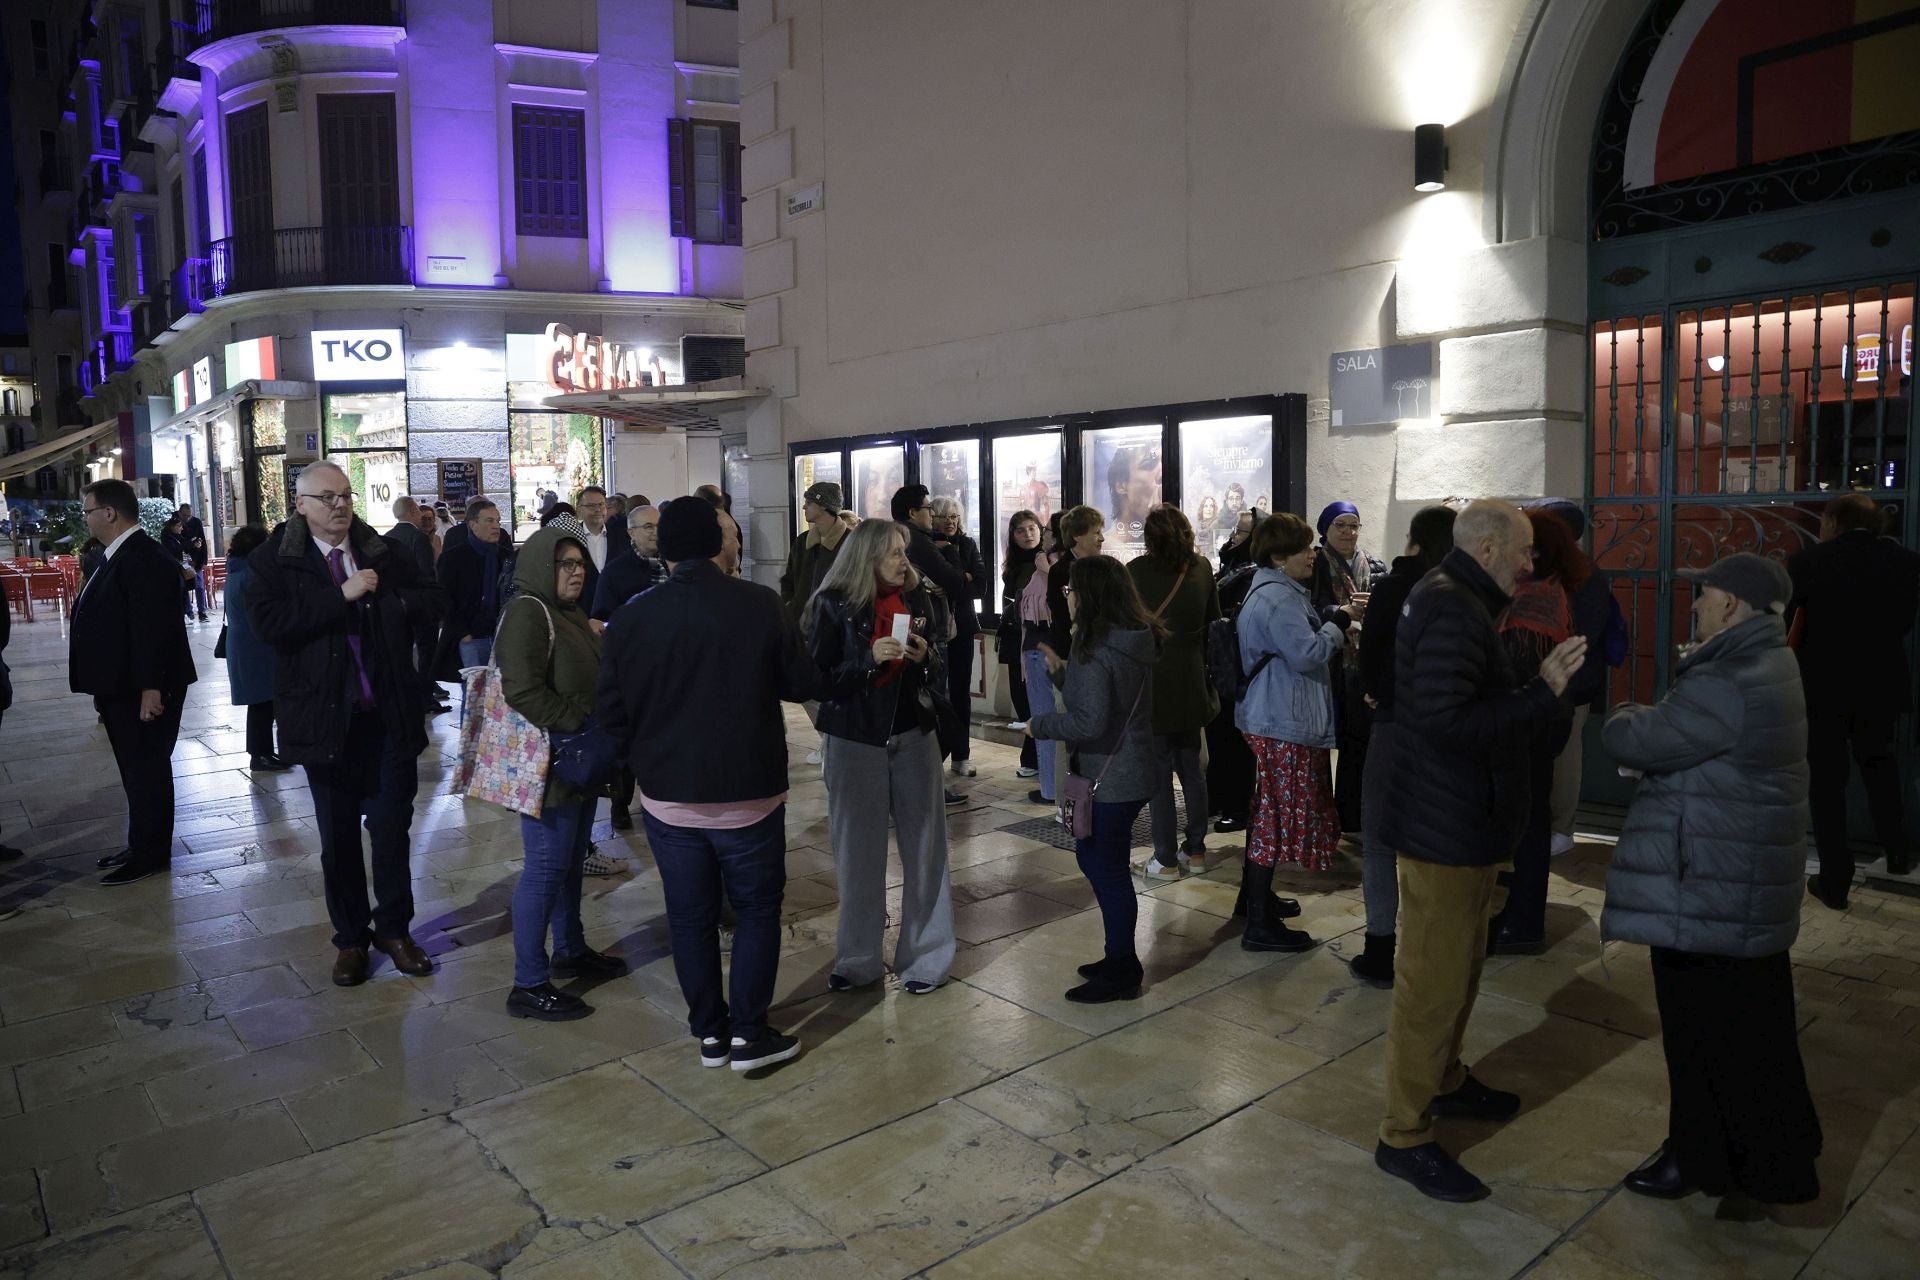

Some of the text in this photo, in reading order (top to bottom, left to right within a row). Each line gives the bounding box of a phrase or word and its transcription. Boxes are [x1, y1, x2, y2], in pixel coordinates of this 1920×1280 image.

[320, 339, 393, 363] TKO
[1336, 354, 1377, 372] SALA
[1730, 399, 1770, 412] SAL 2
[1207, 444, 1248, 461] Siempre
[1223, 456, 1263, 470] invierno
[370, 482, 391, 503] TKO
